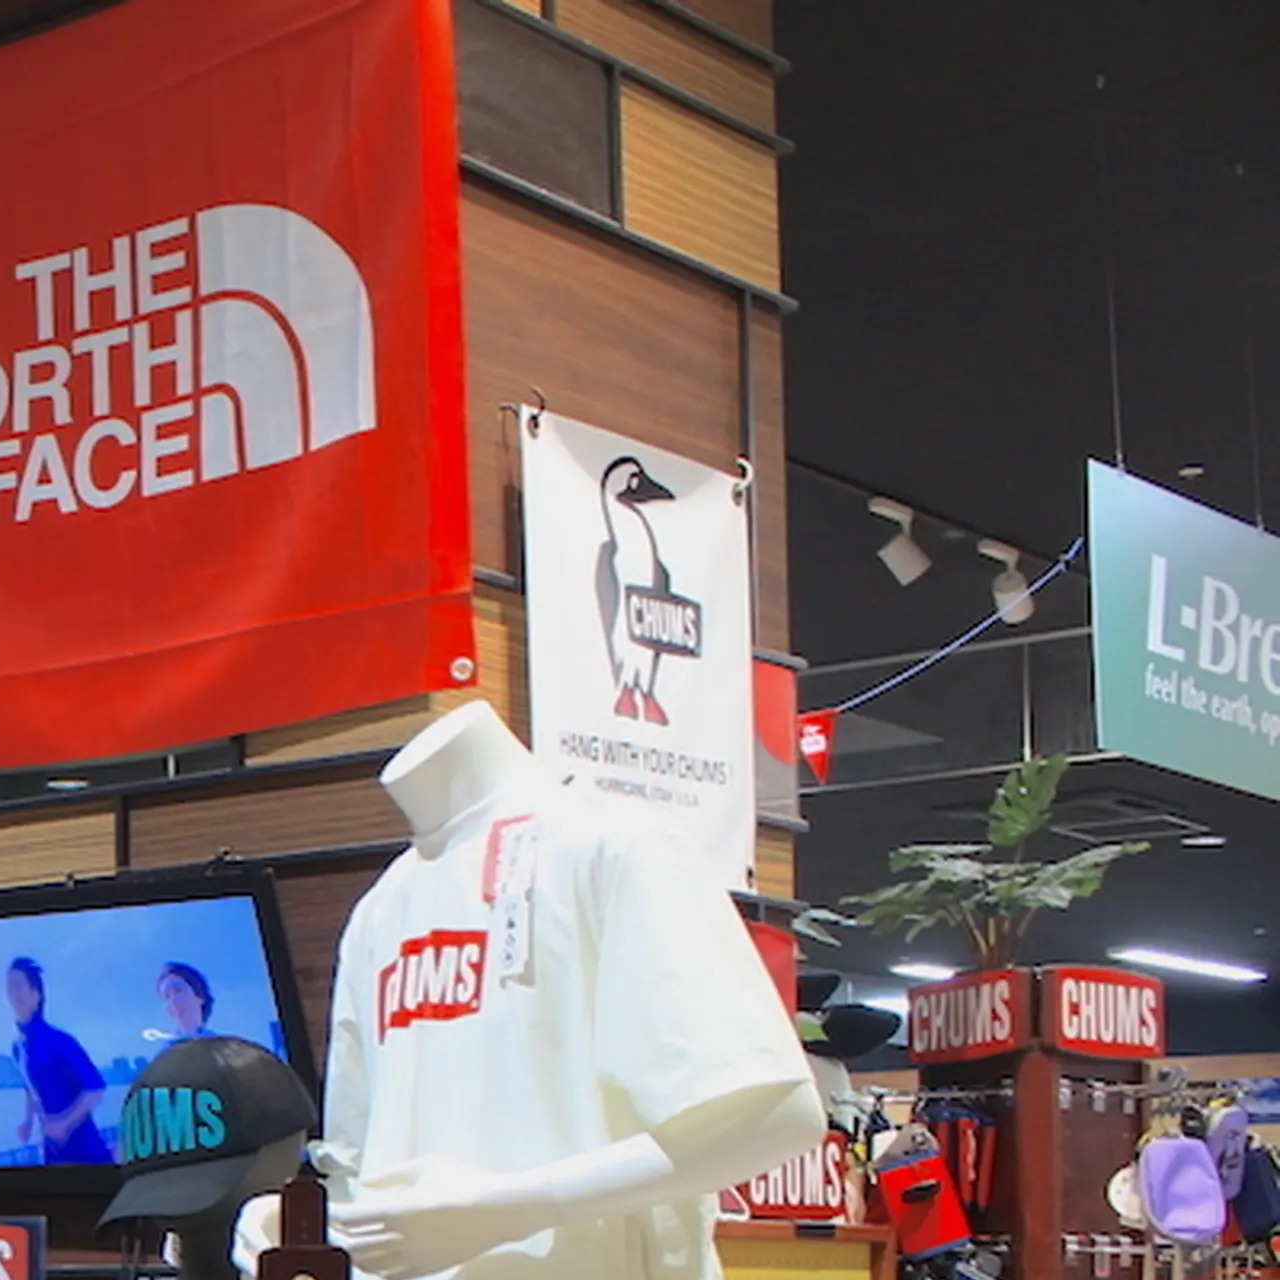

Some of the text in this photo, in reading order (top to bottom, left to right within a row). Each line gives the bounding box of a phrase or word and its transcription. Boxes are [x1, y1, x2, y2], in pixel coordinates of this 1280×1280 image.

[15, 217, 192, 341] THE
[628, 592, 699, 648] CHUMS
[1144, 661, 1179, 705] feel
[1180, 672, 1208, 716] the
[1210, 692, 1258, 736] earth,
[558, 731, 599, 763] HANG
[601, 738, 640, 768] WITH
[641, 748, 676, 775] YOUR
[385, 942, 482, 1026] UMS
[912, 978, 1011, 1053] CHUMS
[1061, 977, 1158, 1048] CHUMS
[124, 1087, 226, 1161] UMS
